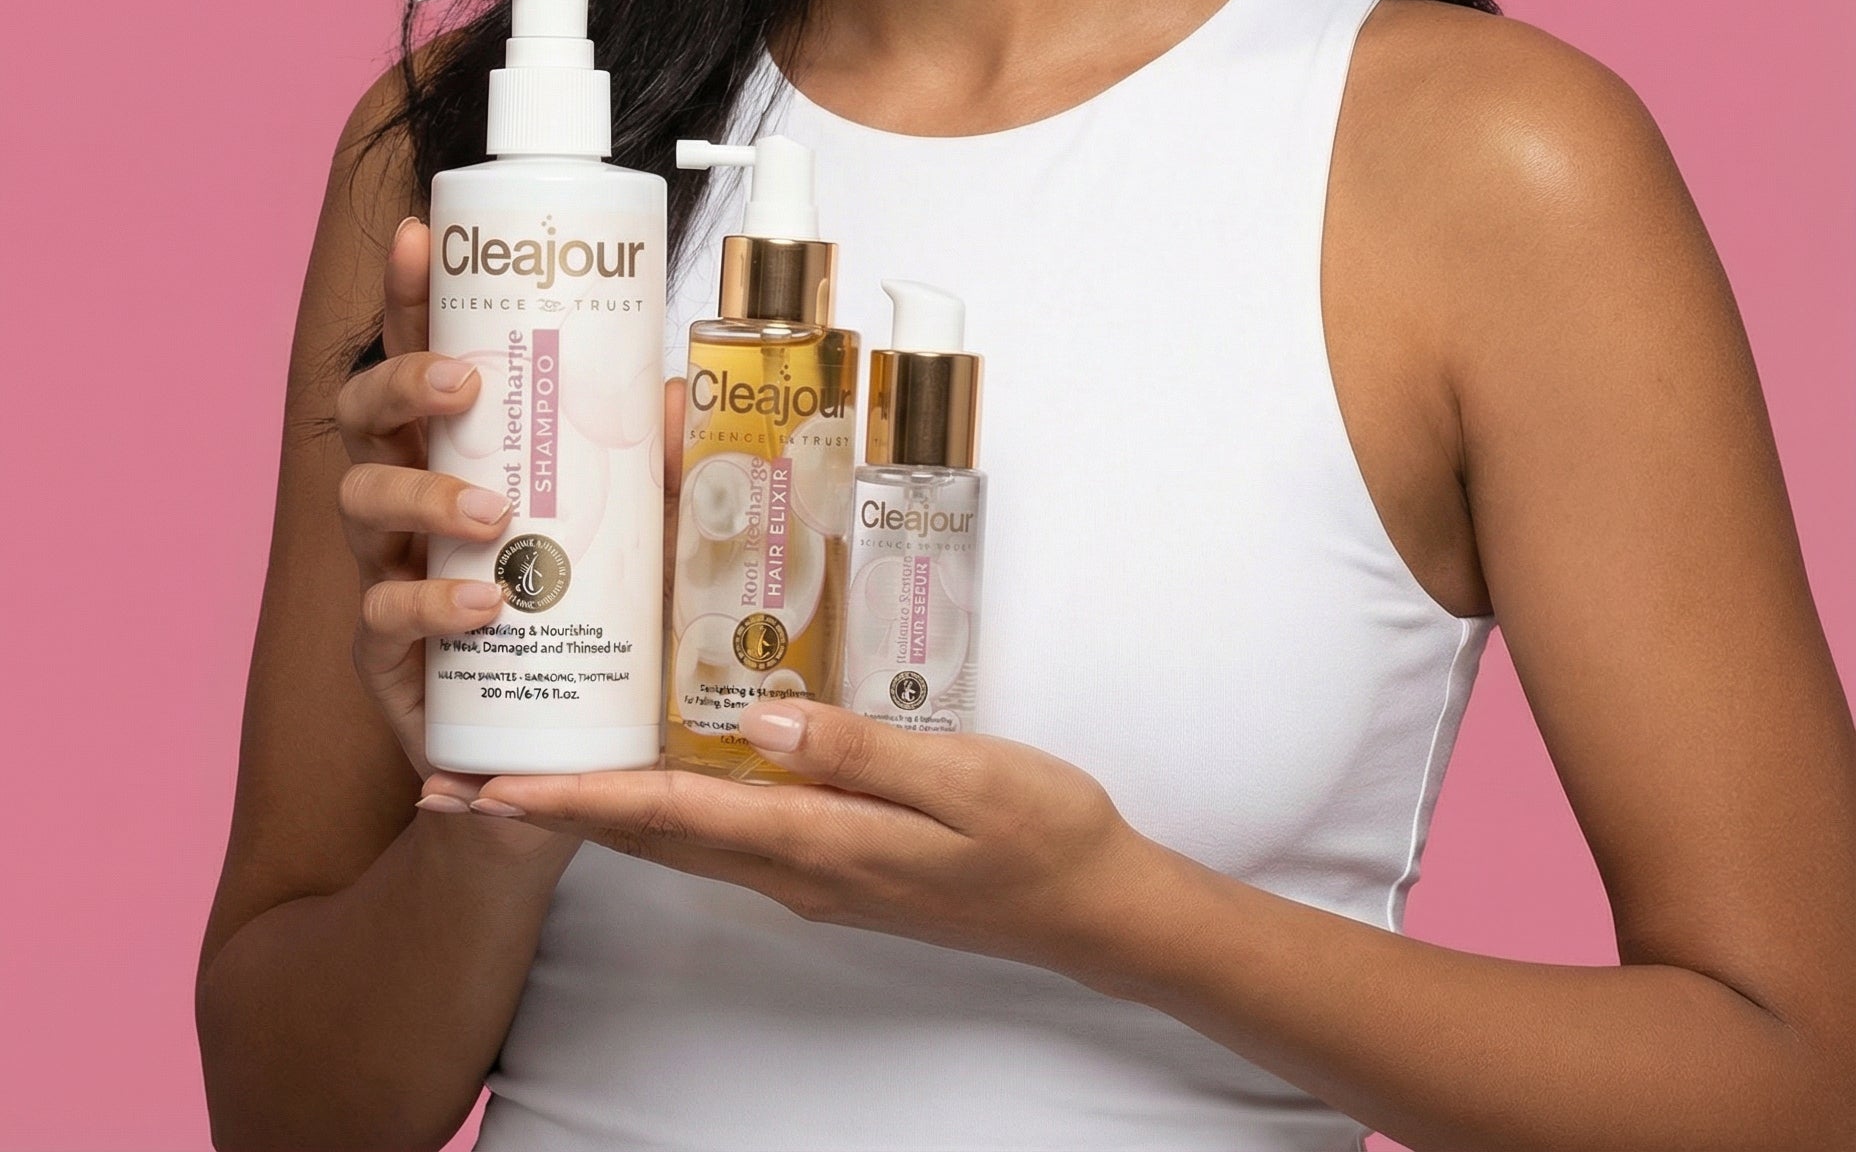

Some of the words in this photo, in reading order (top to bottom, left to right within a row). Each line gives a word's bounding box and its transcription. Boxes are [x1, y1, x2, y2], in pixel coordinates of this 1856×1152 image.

[441, 215, 645, 289] Cleajour
[441, 297, 526, 311] SCIENCE
[574, 298, 644, 313] TRUST
[691, 364, 851, 427] Cleajour
[534, 354, 555, 493] SHAMPOO
[689, 429, 766, 444] SCIENCE
[769, 468, 789, 535] ELIXIR
[861, 497, 974, 538] Cleajour
[767, 545, 785, 597] HAIR
[483, 641, 537, 656] Damaged
[540, 641, 564, 654] and
[528, 625, 538, 637] &
[540, 624, 604, 639] Nourishing
[481, 687, 502, 699] 200
